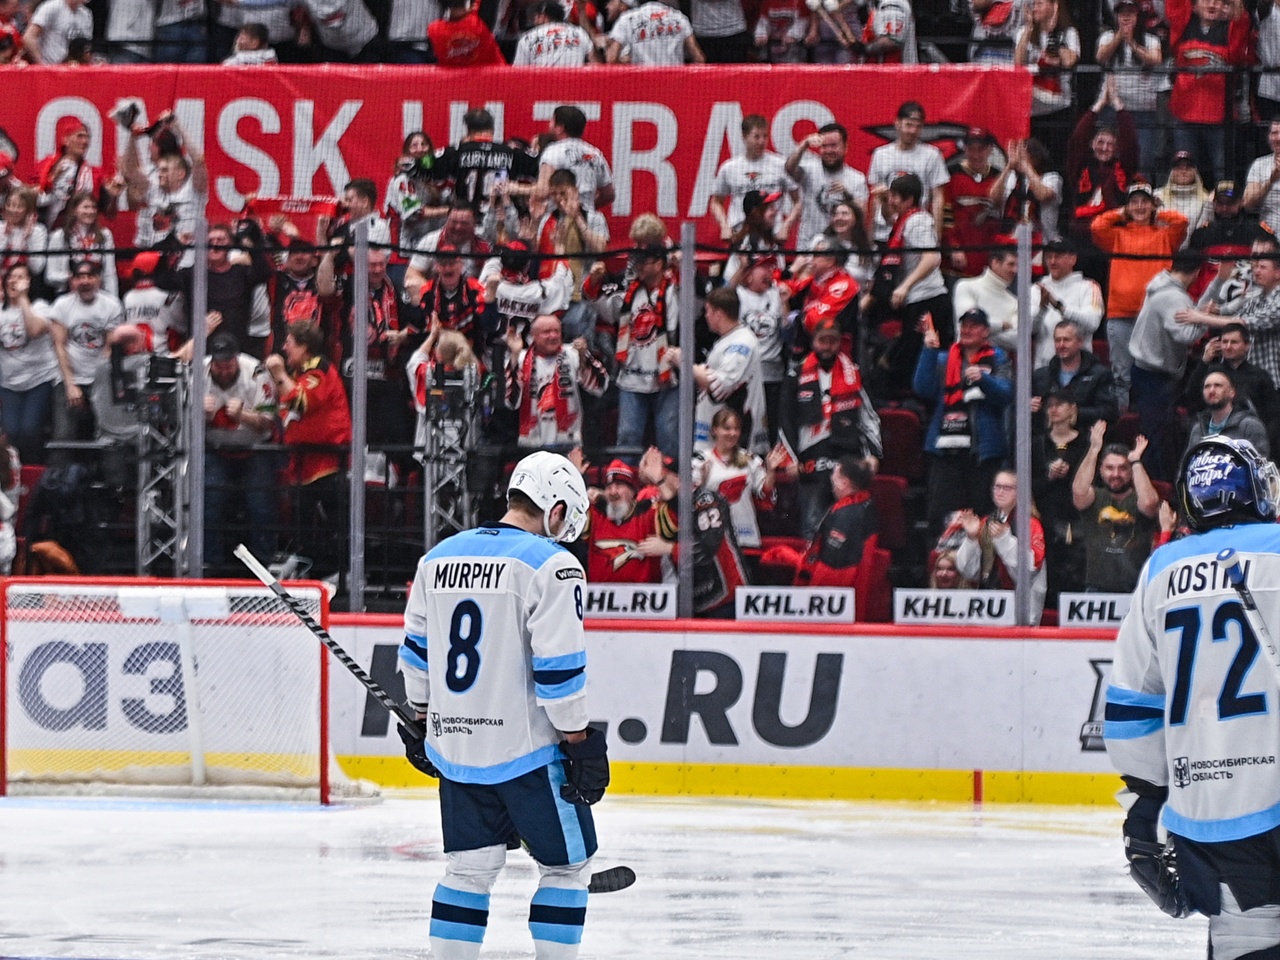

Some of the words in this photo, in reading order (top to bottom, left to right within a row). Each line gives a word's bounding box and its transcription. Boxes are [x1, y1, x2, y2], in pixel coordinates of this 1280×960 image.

[434, 562, 507, 590] MURPHY
[574, 584, 583, 621] 8
[586, 590, 668, 613] HL.RU
[743, 593, 847, 617] KHL.RU
[902, 596, 1008, 621] KHL.RU
[446, 598, 484, 694] 8
[1164, 599, 1270, 727] 72
[1190, 755, 1276, 770] НОВОСИБИРСКАЯ
[1191, 770, 1234, 783] ОБЛАСТЬ
